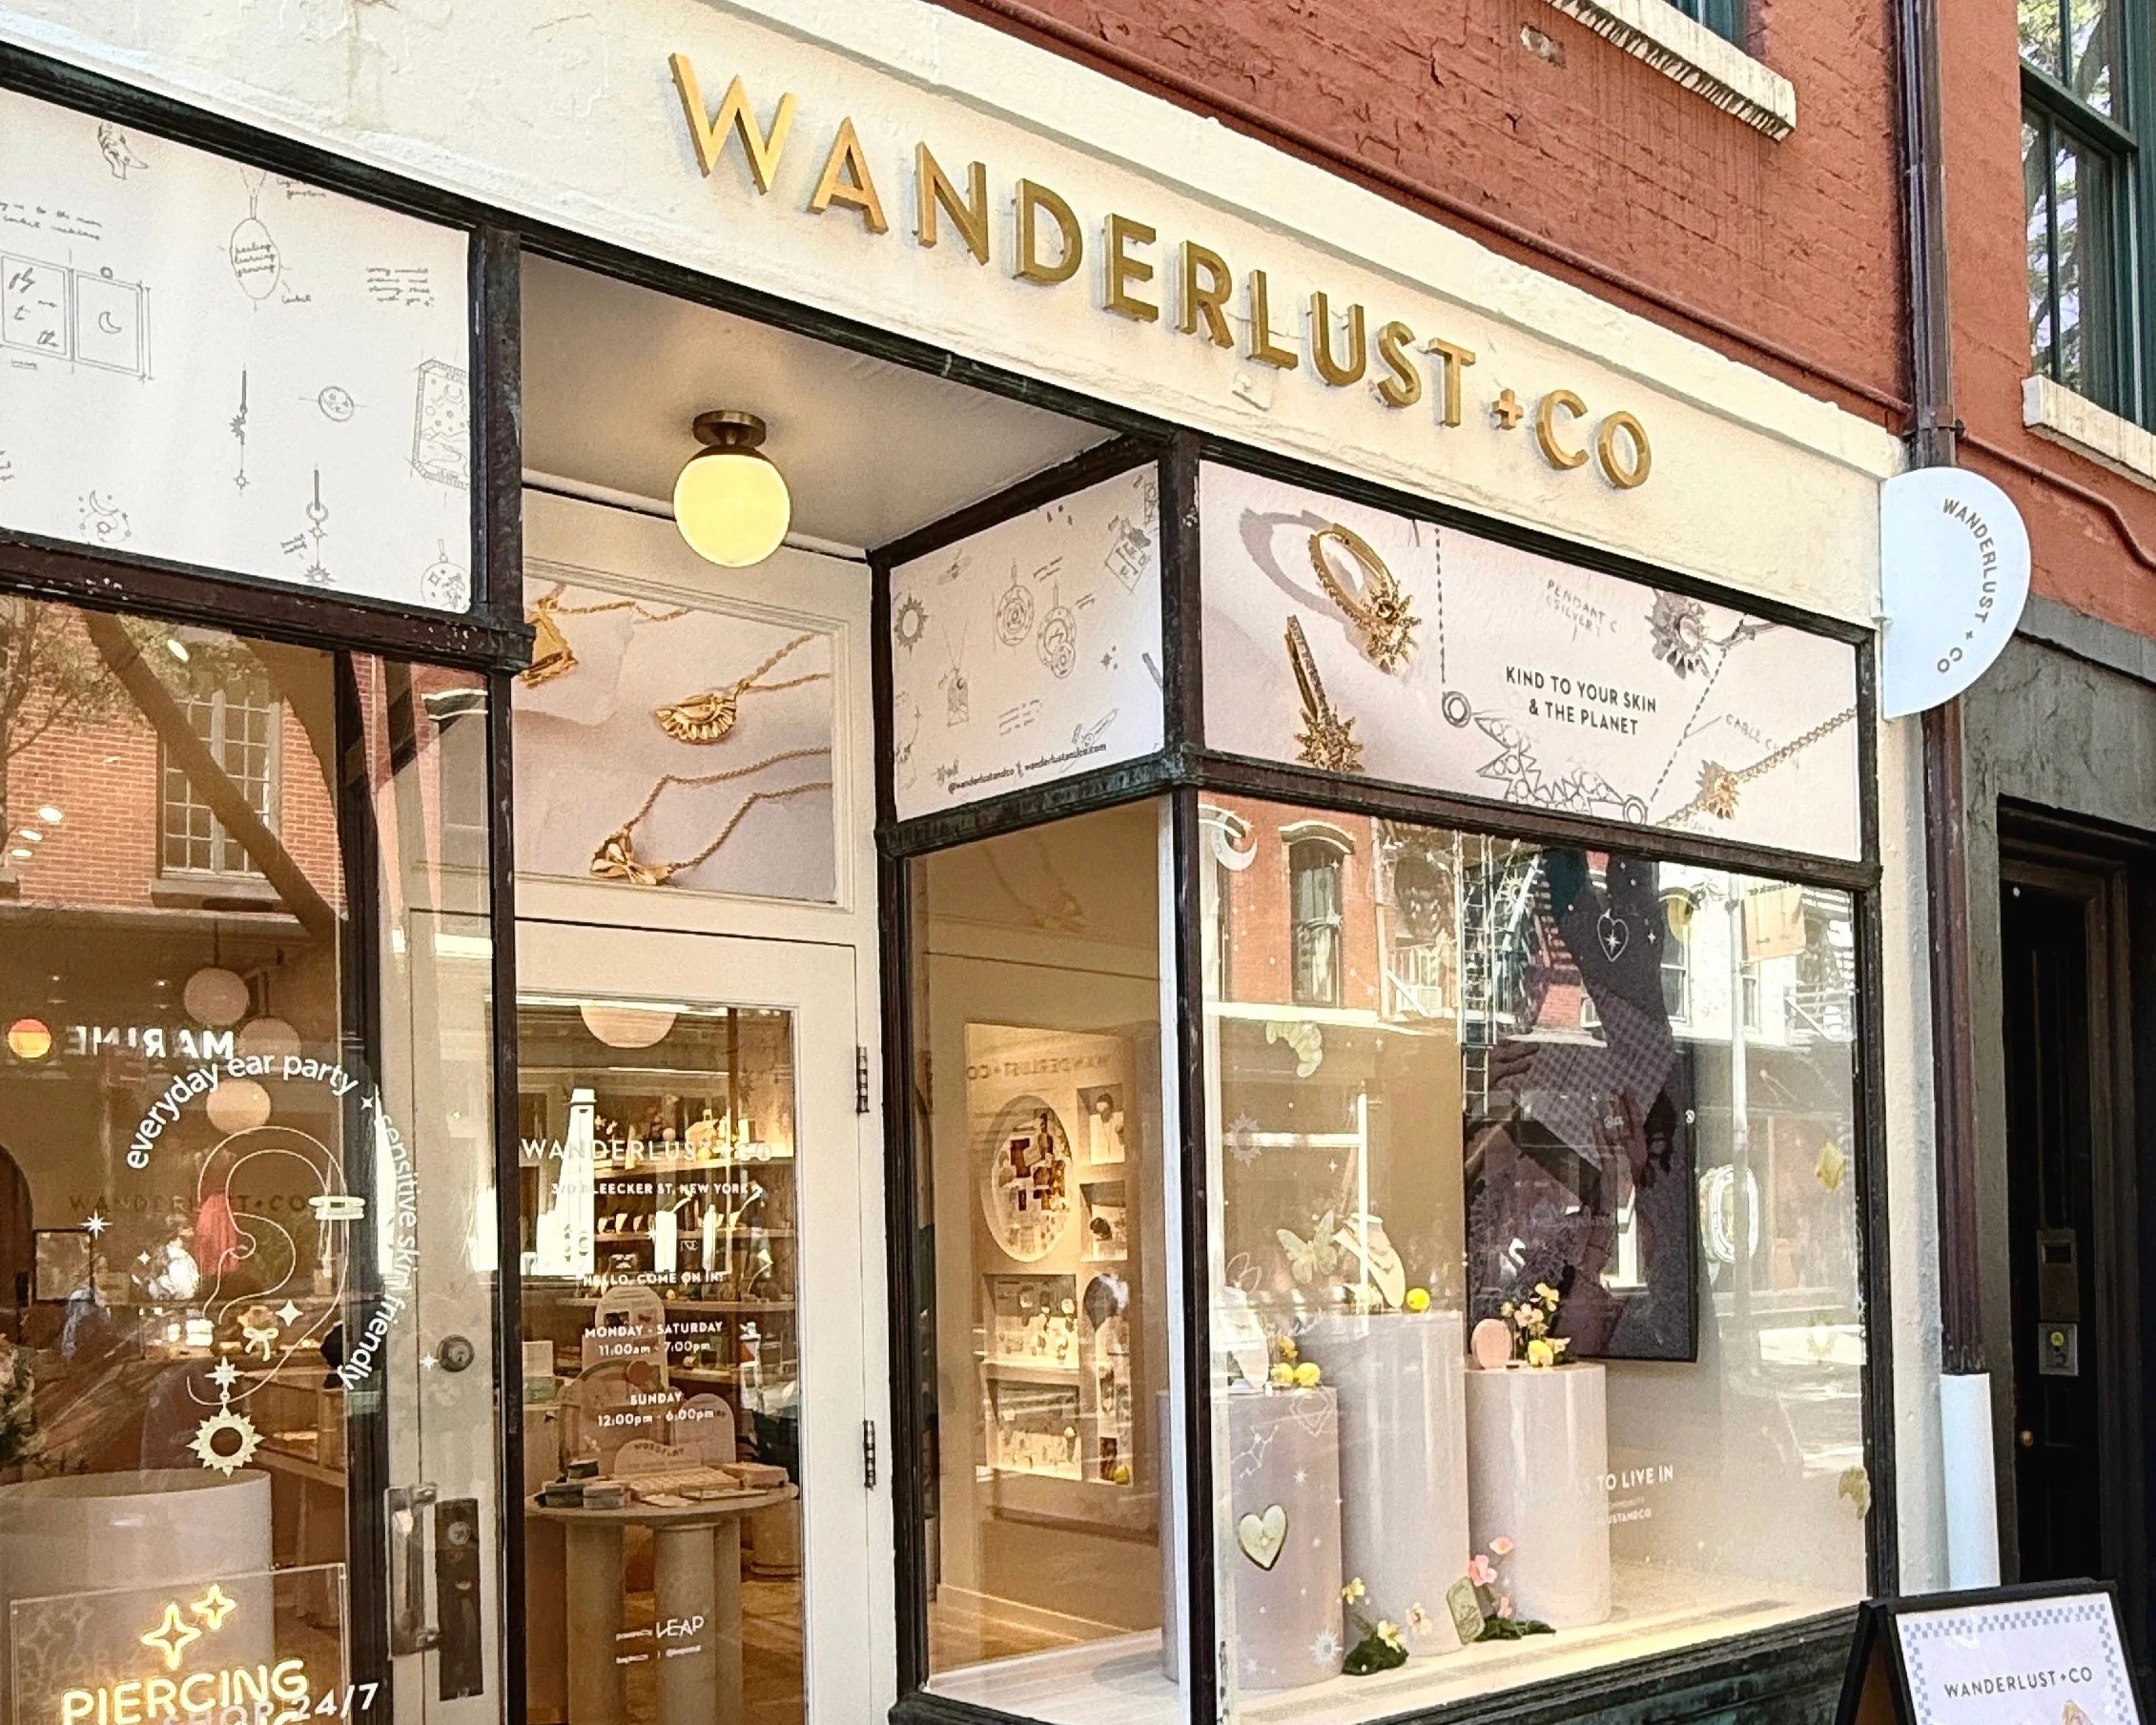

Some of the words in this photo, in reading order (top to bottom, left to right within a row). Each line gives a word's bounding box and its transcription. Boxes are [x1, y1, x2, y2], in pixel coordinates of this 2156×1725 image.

[1942, 498, 1998, 624] WANDERLUST
[1506, 666, 1545, 688] KIND
[1550, 675, 1571, 695] TO
[1576, 681, 1618, 706] YOUR
[1623, 691, 1656, 713] SKIN
[1529, 698, 1539, 716] &
[1545, 701, 1574, 723] THE
[1581, 708, 1638, 735] PLANET
[227, 1055, 276, 1078] ear
[282, 1055, 359, 1097] party
[127, 1063, 218, 1170] everyday
[380, 1114, 421, 1227] sensitive
[680, 1182, 709, 1195] NEW
[636, 1272, 677, 1285] COME
[681, 1271, 702, 1283] ON
[337, 1293, 407, 1390] friendly
[585, 1325, 644, 1338] MONDAY
[656, 1321, 723, 1335] SATURDAY
[629, 1391, 685, 1406] SUNDAY
[598, 1412, 653, 1427] 12:00pm
[665, 1408, 714, 1422] 6:00pm
[1622, 1467, 1654, 1489] LIVE
[1659, 1464, 1673, 1483] IN
[656, 1614, 706, 1639] LEAP
[62, 1659, 307, 1725] PIERCING
[290, 1681, 379, 1723] 24/7
